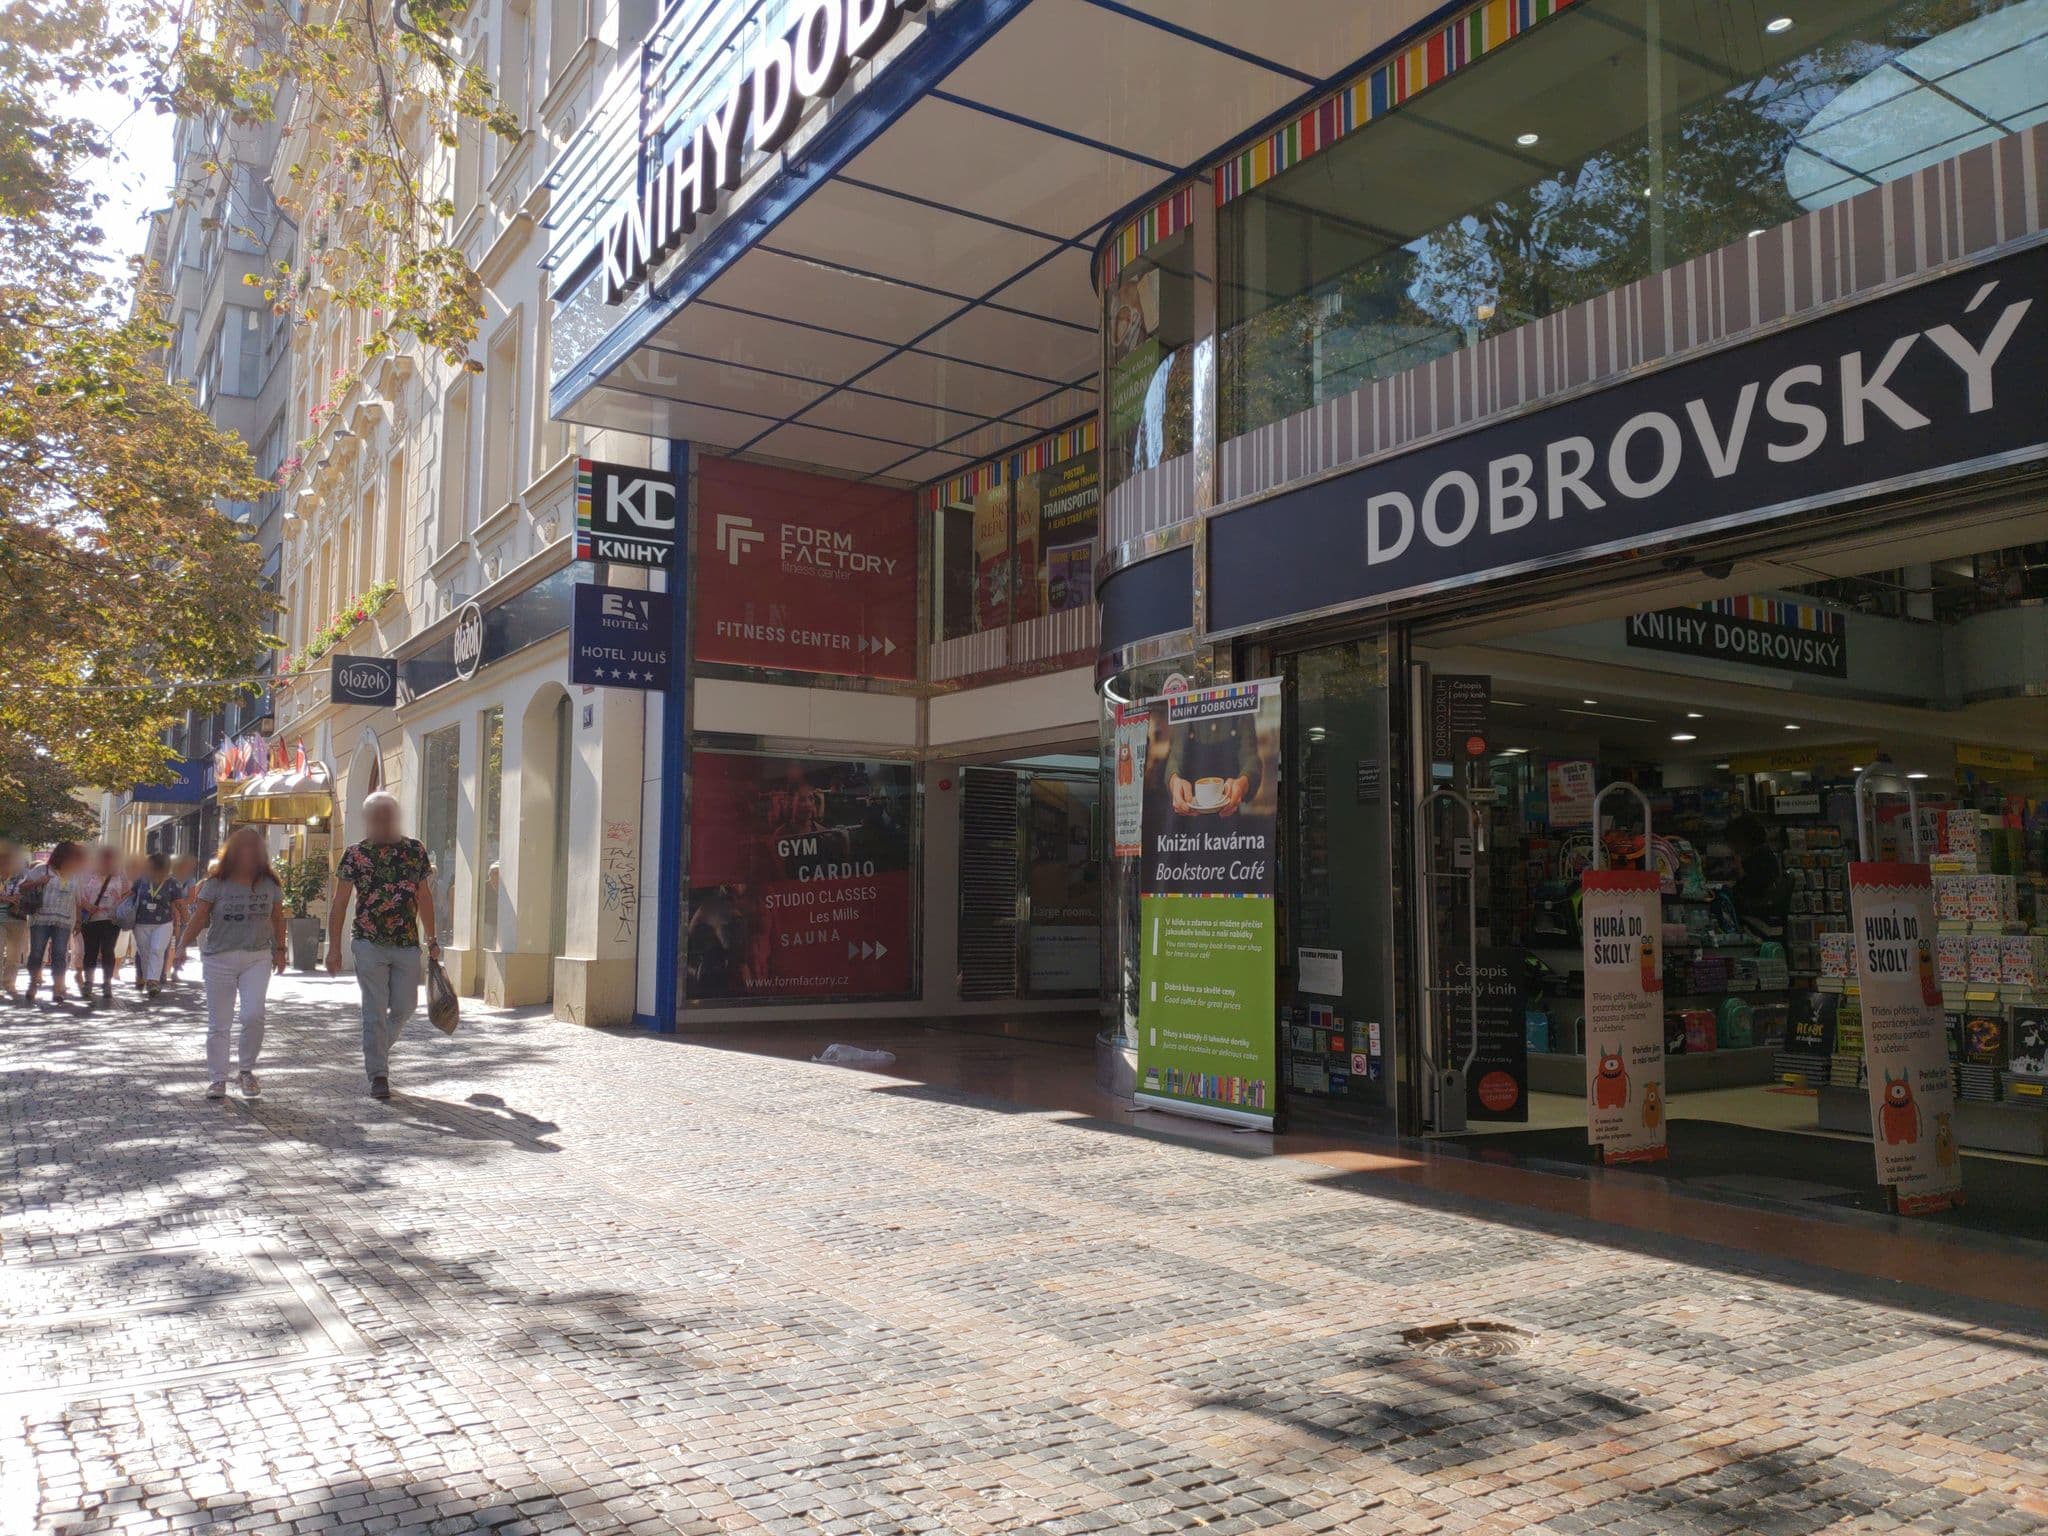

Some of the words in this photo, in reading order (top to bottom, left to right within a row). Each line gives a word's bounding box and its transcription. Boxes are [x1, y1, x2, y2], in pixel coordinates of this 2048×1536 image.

[602, 83, 743, 305] KNIHY
[1366, 279, 2033, 566] DOBROVSKÝ
[1043, 487, 1099, 519] TRAINSPOTTIN
[781, 524, 853, 551] FORM
[598, 540, 669, 565] KNIHY
[781, 543, 897, 575] FACTORY
[601, 618, 649, 631] HOTELS
[716, 621, 785, 643] FITNESS
[791, 630, 851, 650] CENTER
[1633, 612, 1707, 646] KNIHY
[1714, 623, 1840, 668] DOBROVSKÝ
[581, 645, 626, 662] HOTEL
[631, 649, 667, 665] JULIŠ
[339, 670, 385, 690] Blažek
[1171, 705, 1199, 718] KNIHY
[1200, 695, 1256, 713] DOBROVSKÝ
[778, 838, 818, 857] GYM
[1157, 832, 1200, 852] Knižní
[1204, 830, 1265, 851] kavárna
[798, 861, 875, 883] CARDIO
[1156, 861, 1224, 881] Bookstore
[1229, 860, 1265, 881] Café
[765, 890, 815, 909] STUDIO
[819, 886, 877, 904] CLASSES
[809, 910, 830, 924] Les
[833, 906, 860, 922] Mills
[1594, 909, 1626, 938] HURÁ
[1628, 916, 1642, 937] DO
[1865, 908, 1901, 942] HURÁ
[1903, 916, 1918, 940] DO
[780, 929, 841, 947] SAUNA
[1594, 940, 1631, 965] ŠKOLY
[1868, 941, 1909, 973] ŠKOLY
[745, 974, 849, 988] www.formfactory.cz
[1455, 982, 1484, 998] plý
[1488, 983, 1517, 995] knih
